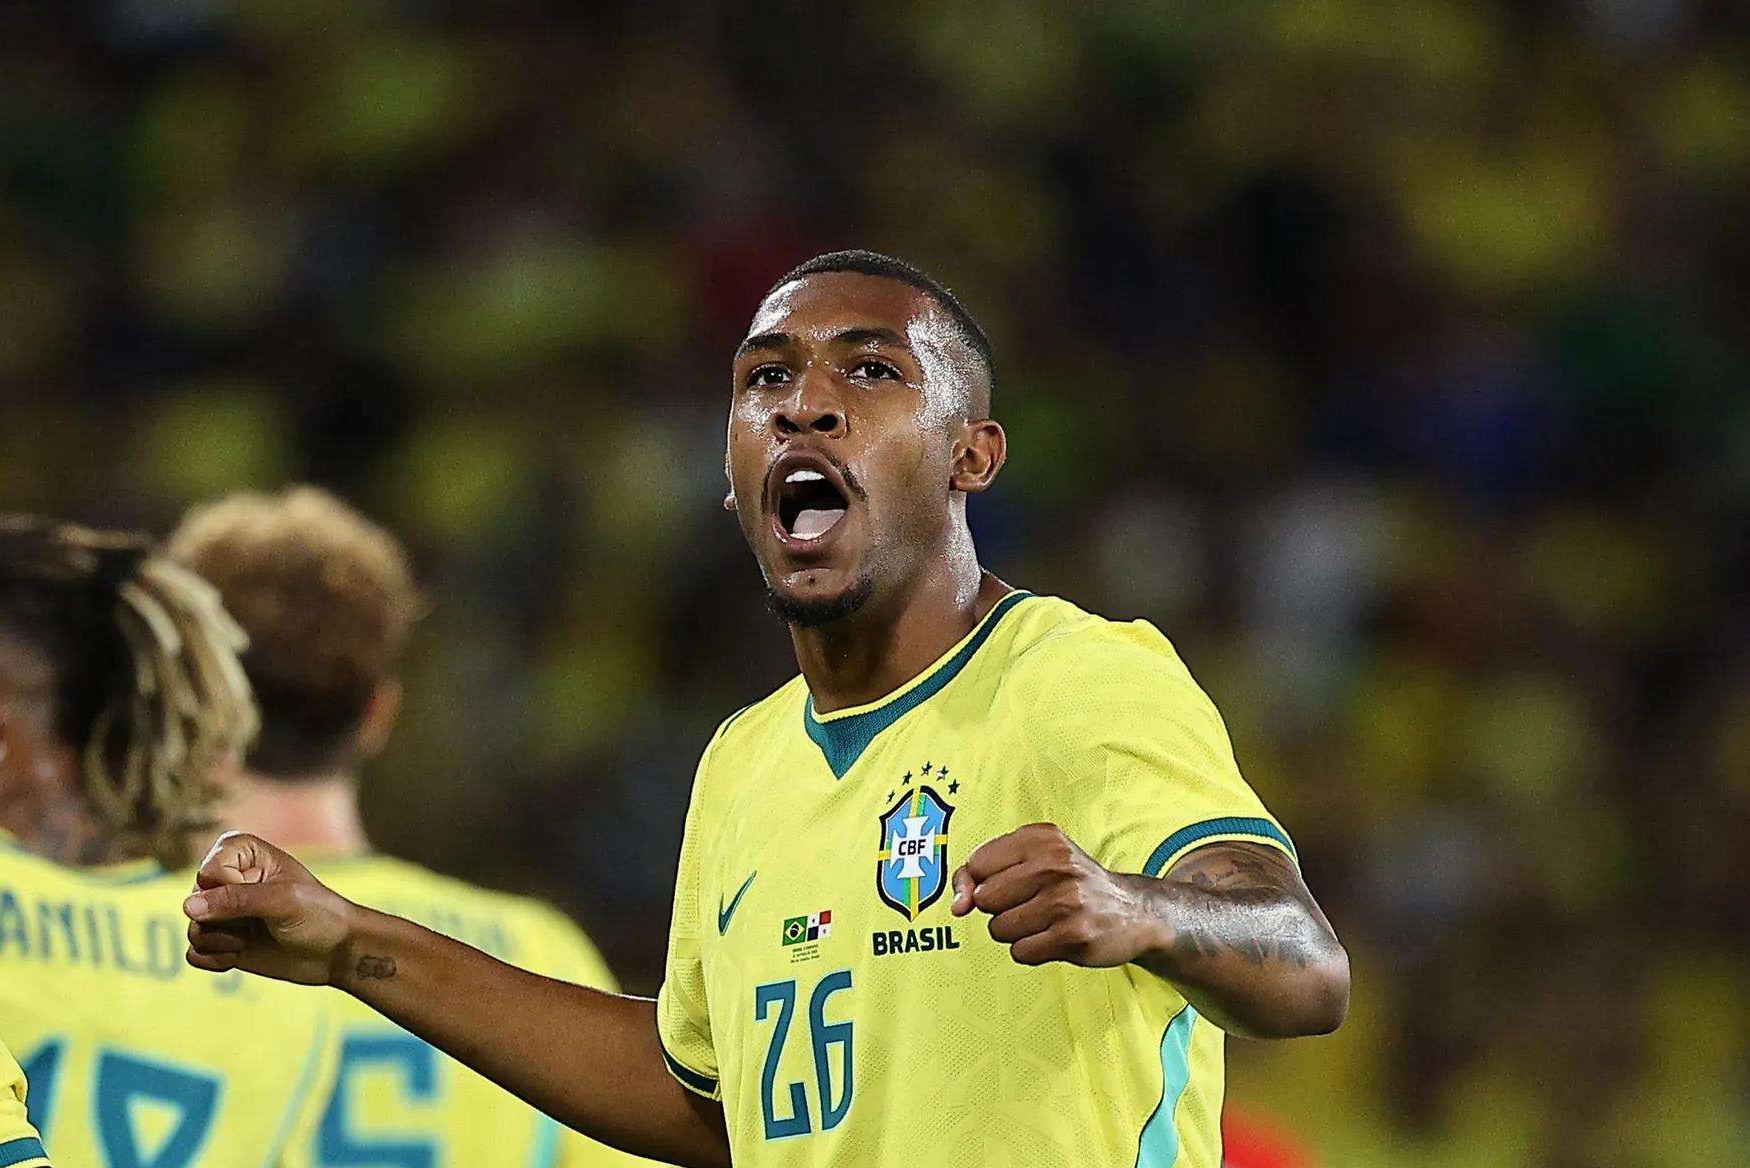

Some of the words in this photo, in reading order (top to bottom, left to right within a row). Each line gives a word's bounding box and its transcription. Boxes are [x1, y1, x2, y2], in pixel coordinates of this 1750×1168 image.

[898, 838, 927, 856] CBF
[872, 926, 960, 956] BRASIL
[754, 969, 854, 1142] 26
